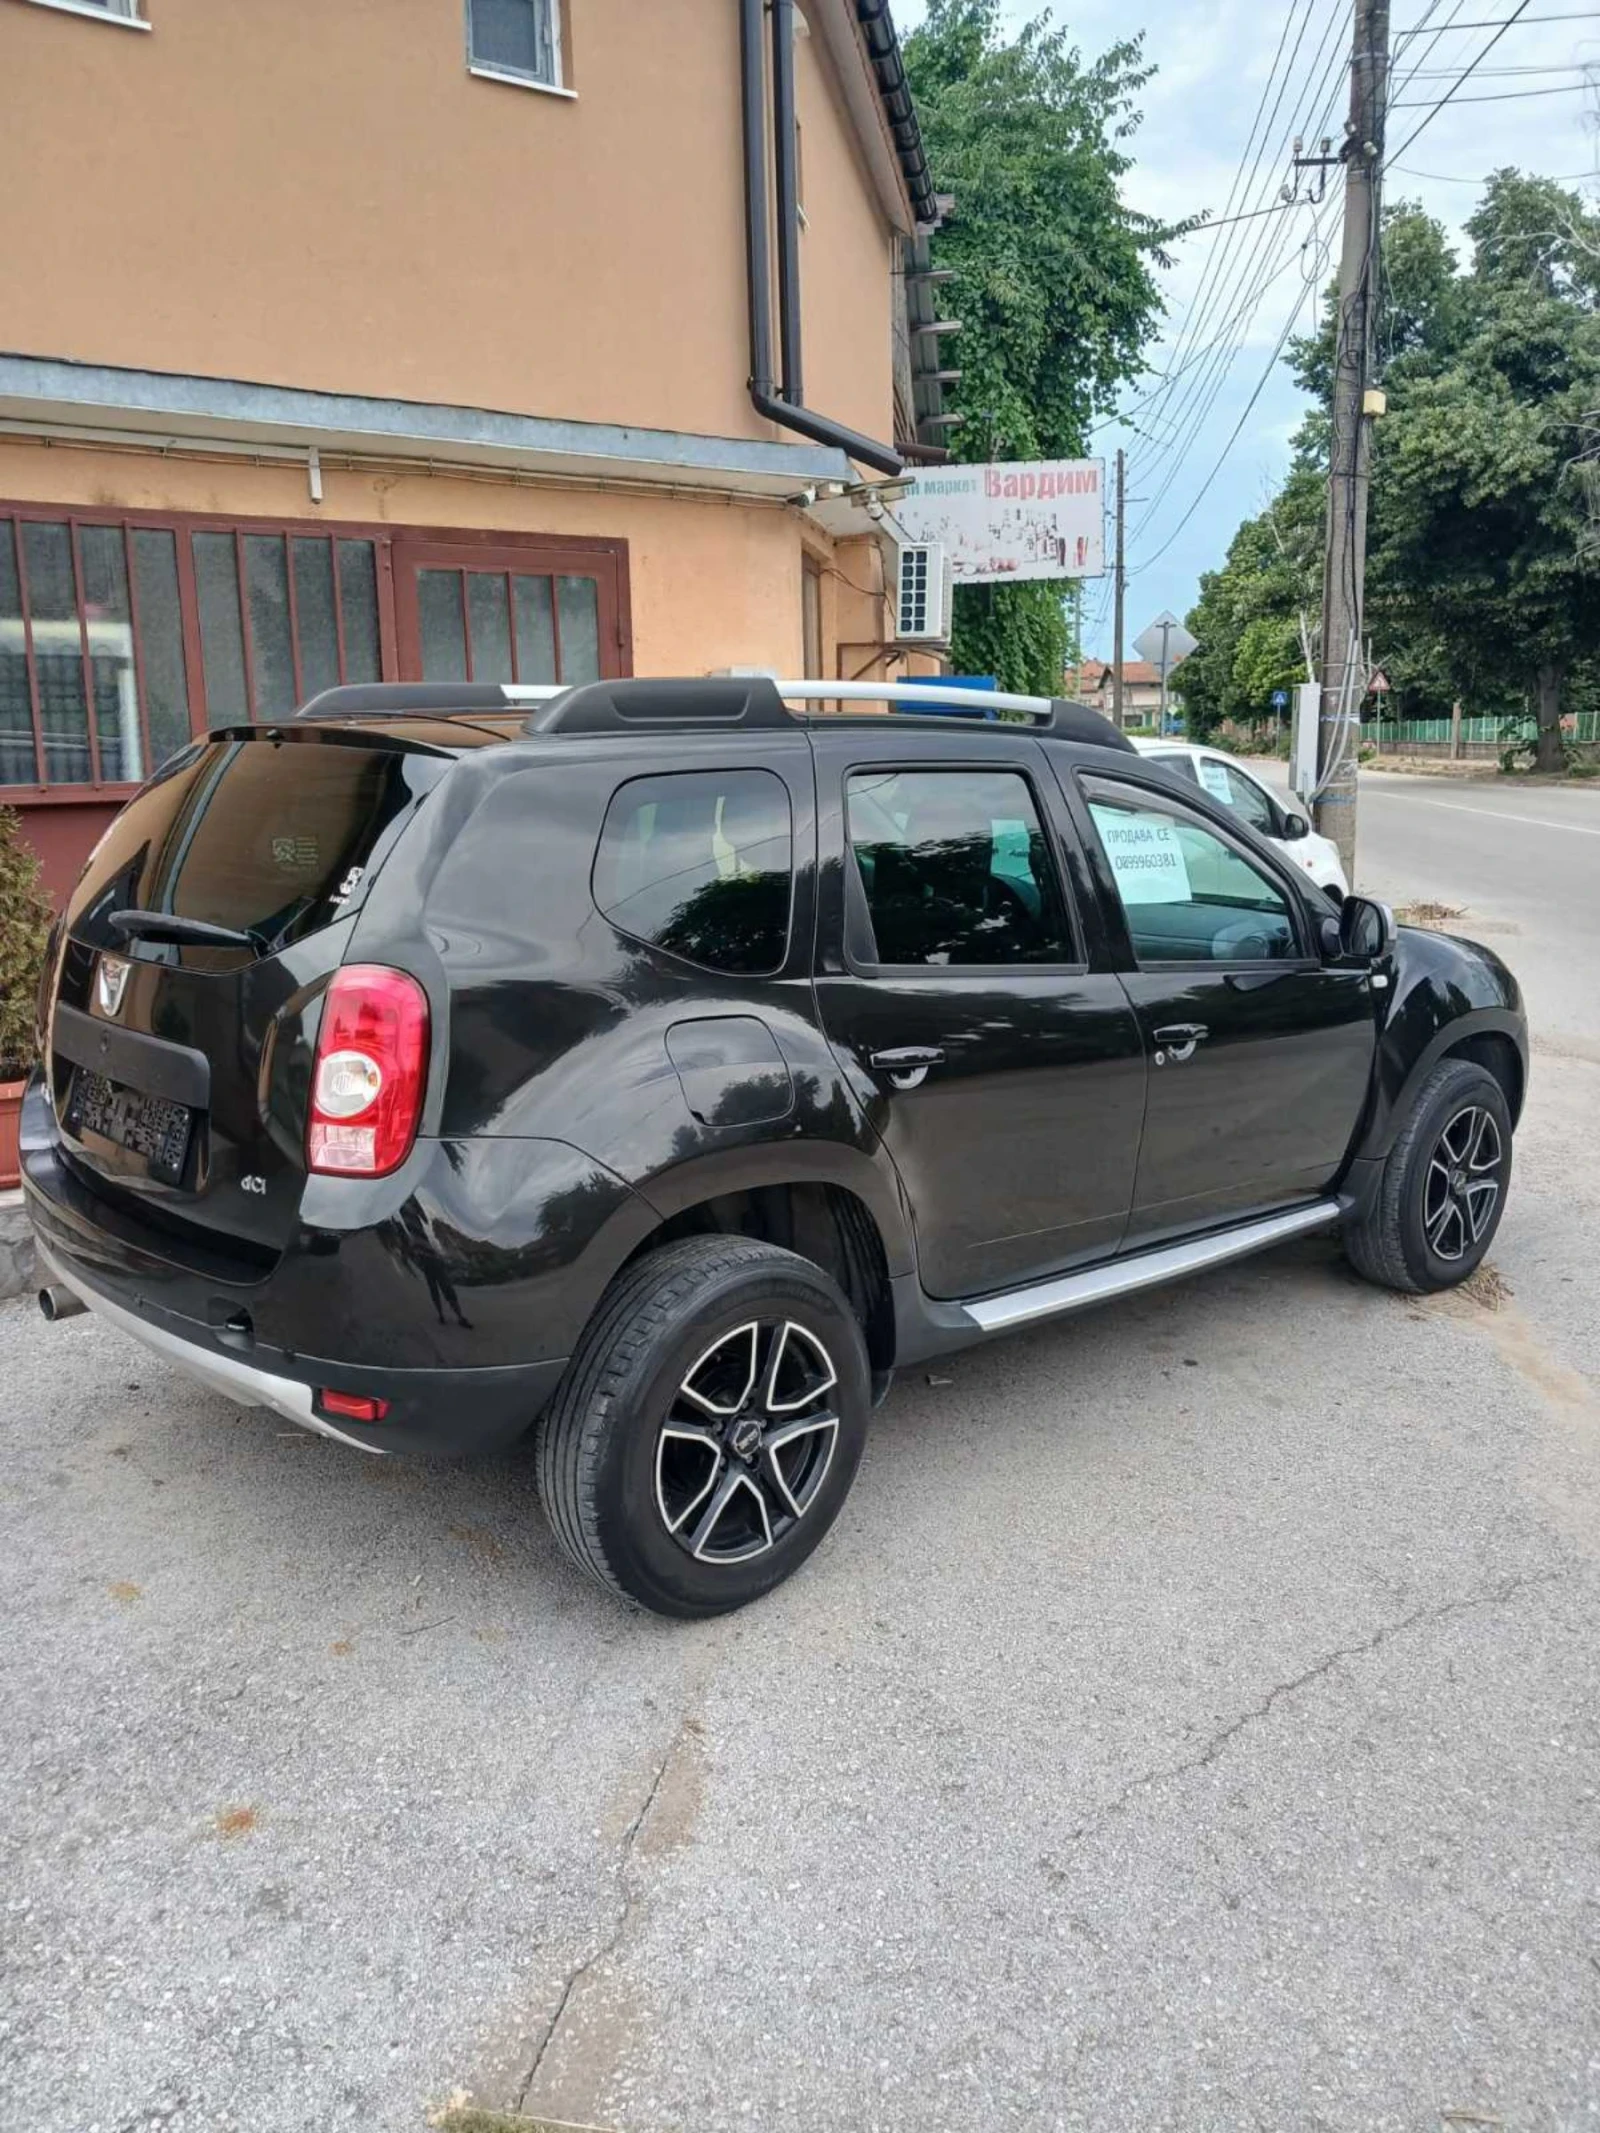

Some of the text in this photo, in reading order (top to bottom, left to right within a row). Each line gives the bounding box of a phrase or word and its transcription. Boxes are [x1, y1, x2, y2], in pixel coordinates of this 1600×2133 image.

[924, 479, 977, 495] маркет
[984, 468, 1097, 500] Вардим
[1107, 828, 1171, 845] ПРОДАВА СЕ
